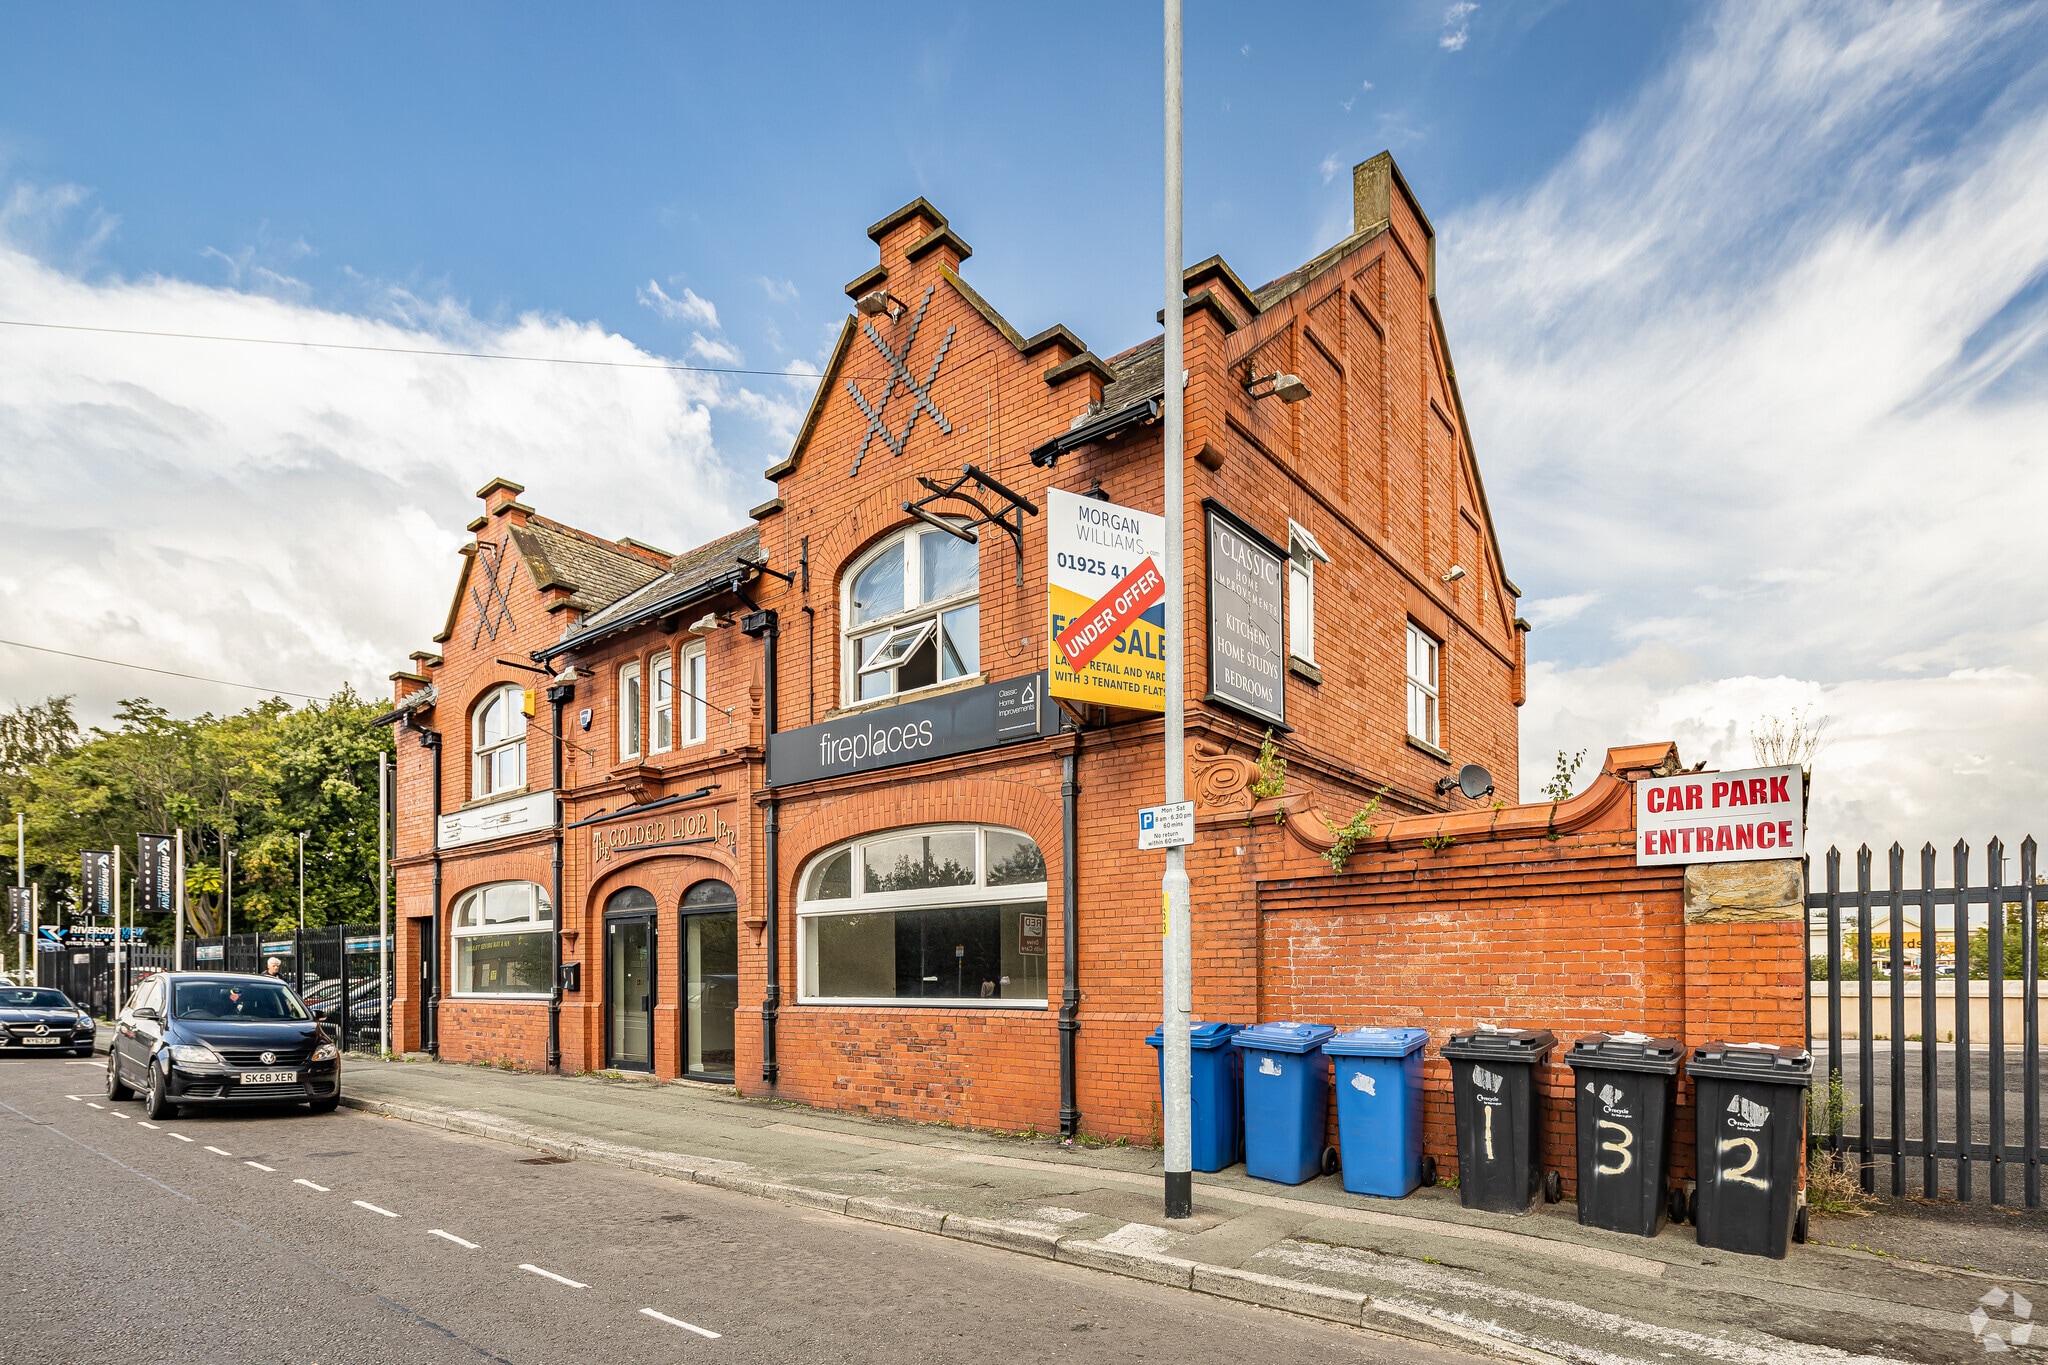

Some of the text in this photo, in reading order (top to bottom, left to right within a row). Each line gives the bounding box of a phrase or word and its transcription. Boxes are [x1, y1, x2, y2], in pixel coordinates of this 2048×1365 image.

[1079, 505, 1140, 535] MORGAN
[1076, 524, 1144, 555] WILLIAMS
[1057, 552, 1106, 576] 01925
[1220, 532, 1274, 585] CLASSIC
[1216, 570, 1277, 617] IMPROVEMENTS
[1235, 569, 1259, 592] HOME
[1065, 607, 1117, 658] UNDER
[1114, 569, 1160, 615] OFFER
[1226, 613, 1270, 650] KITCHENS
[1090, 660, 1121, 675] RETAIL
[1123, 666, 1143, 678] AND
[1217, 636, 1278, 680] HOME STUDYS
[999, 688, 1018, 698] Classic
[1055, 670, 1080, 684] WITH
[1083, 675, 1089, 685] 3
[1092, 677, 1140, 693] TENANTED
[1224, 667, 1273, 703] BEDROOMS
[999, 699, 1015, 707] Home
[999, 703, 1035, 717] Improvements
[820, 720, 933, 767] fireplaces
[1647, 775, 1790, 814] CAR PARK
[609, 821, 665, 847] GOLDEN
[671, 813, 707, 840] LION
[1645, 820, 1793, 855] ENTRANCE
[245, 1073, 293, 1082] SK58 XER
[1484, 1105, 1494, 1160] 1
[1599, 1120, 1633, 1175] 3
[1721, 1137, 1769, 1190] 2
